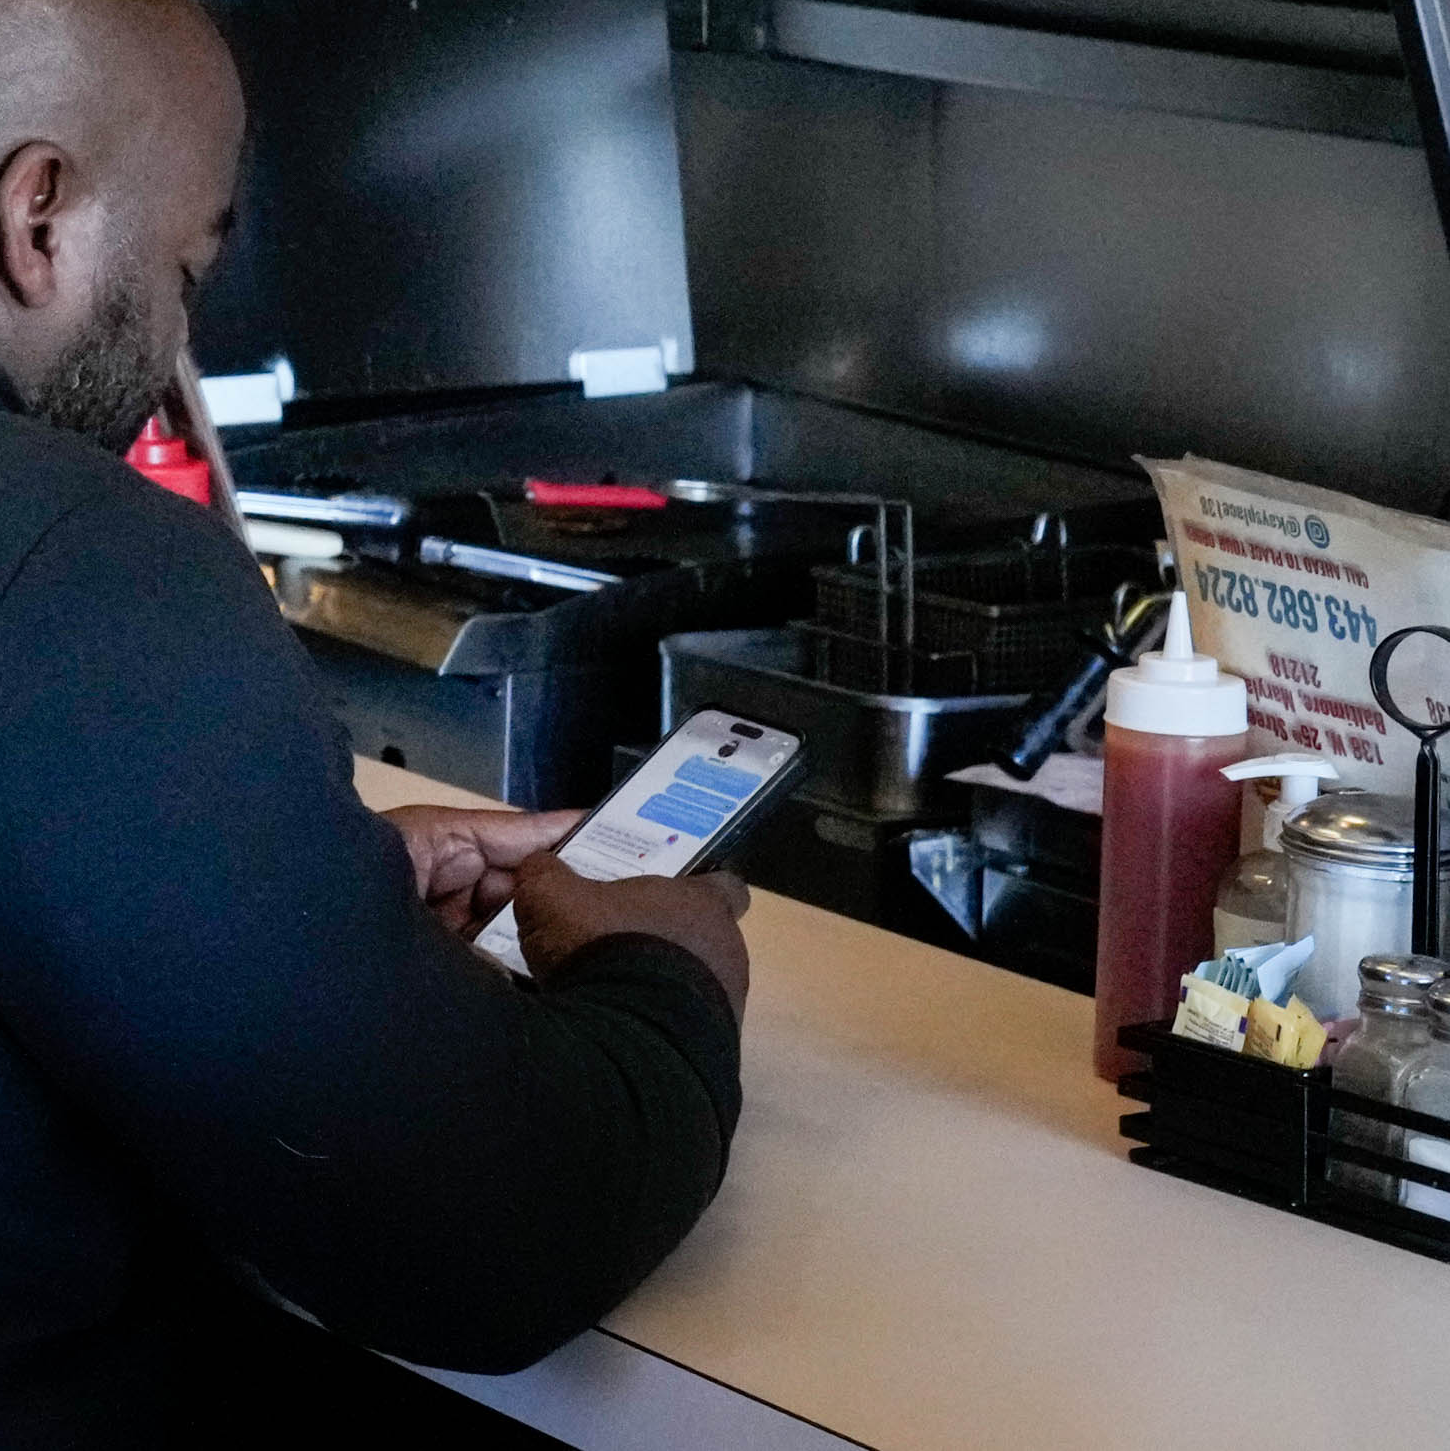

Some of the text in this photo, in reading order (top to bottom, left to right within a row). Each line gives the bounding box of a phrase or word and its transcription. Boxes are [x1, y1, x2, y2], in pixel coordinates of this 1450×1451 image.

[1248, 540, 1284, 567] PLACE
[1285, 550, 1303, 571] TO
[1303, 555, 1341, 580] AHEAD
[1343, 563, 1369, 589] CALL
[1195, 560, 1377, 648] 443.682.8224
[1269, 653, 1321, 689] 21218
[1246, 677, 1296, 713] Maryla
[1247, 708, 1288, 741] Stree
[1348, 736, 1384, 765] 138
